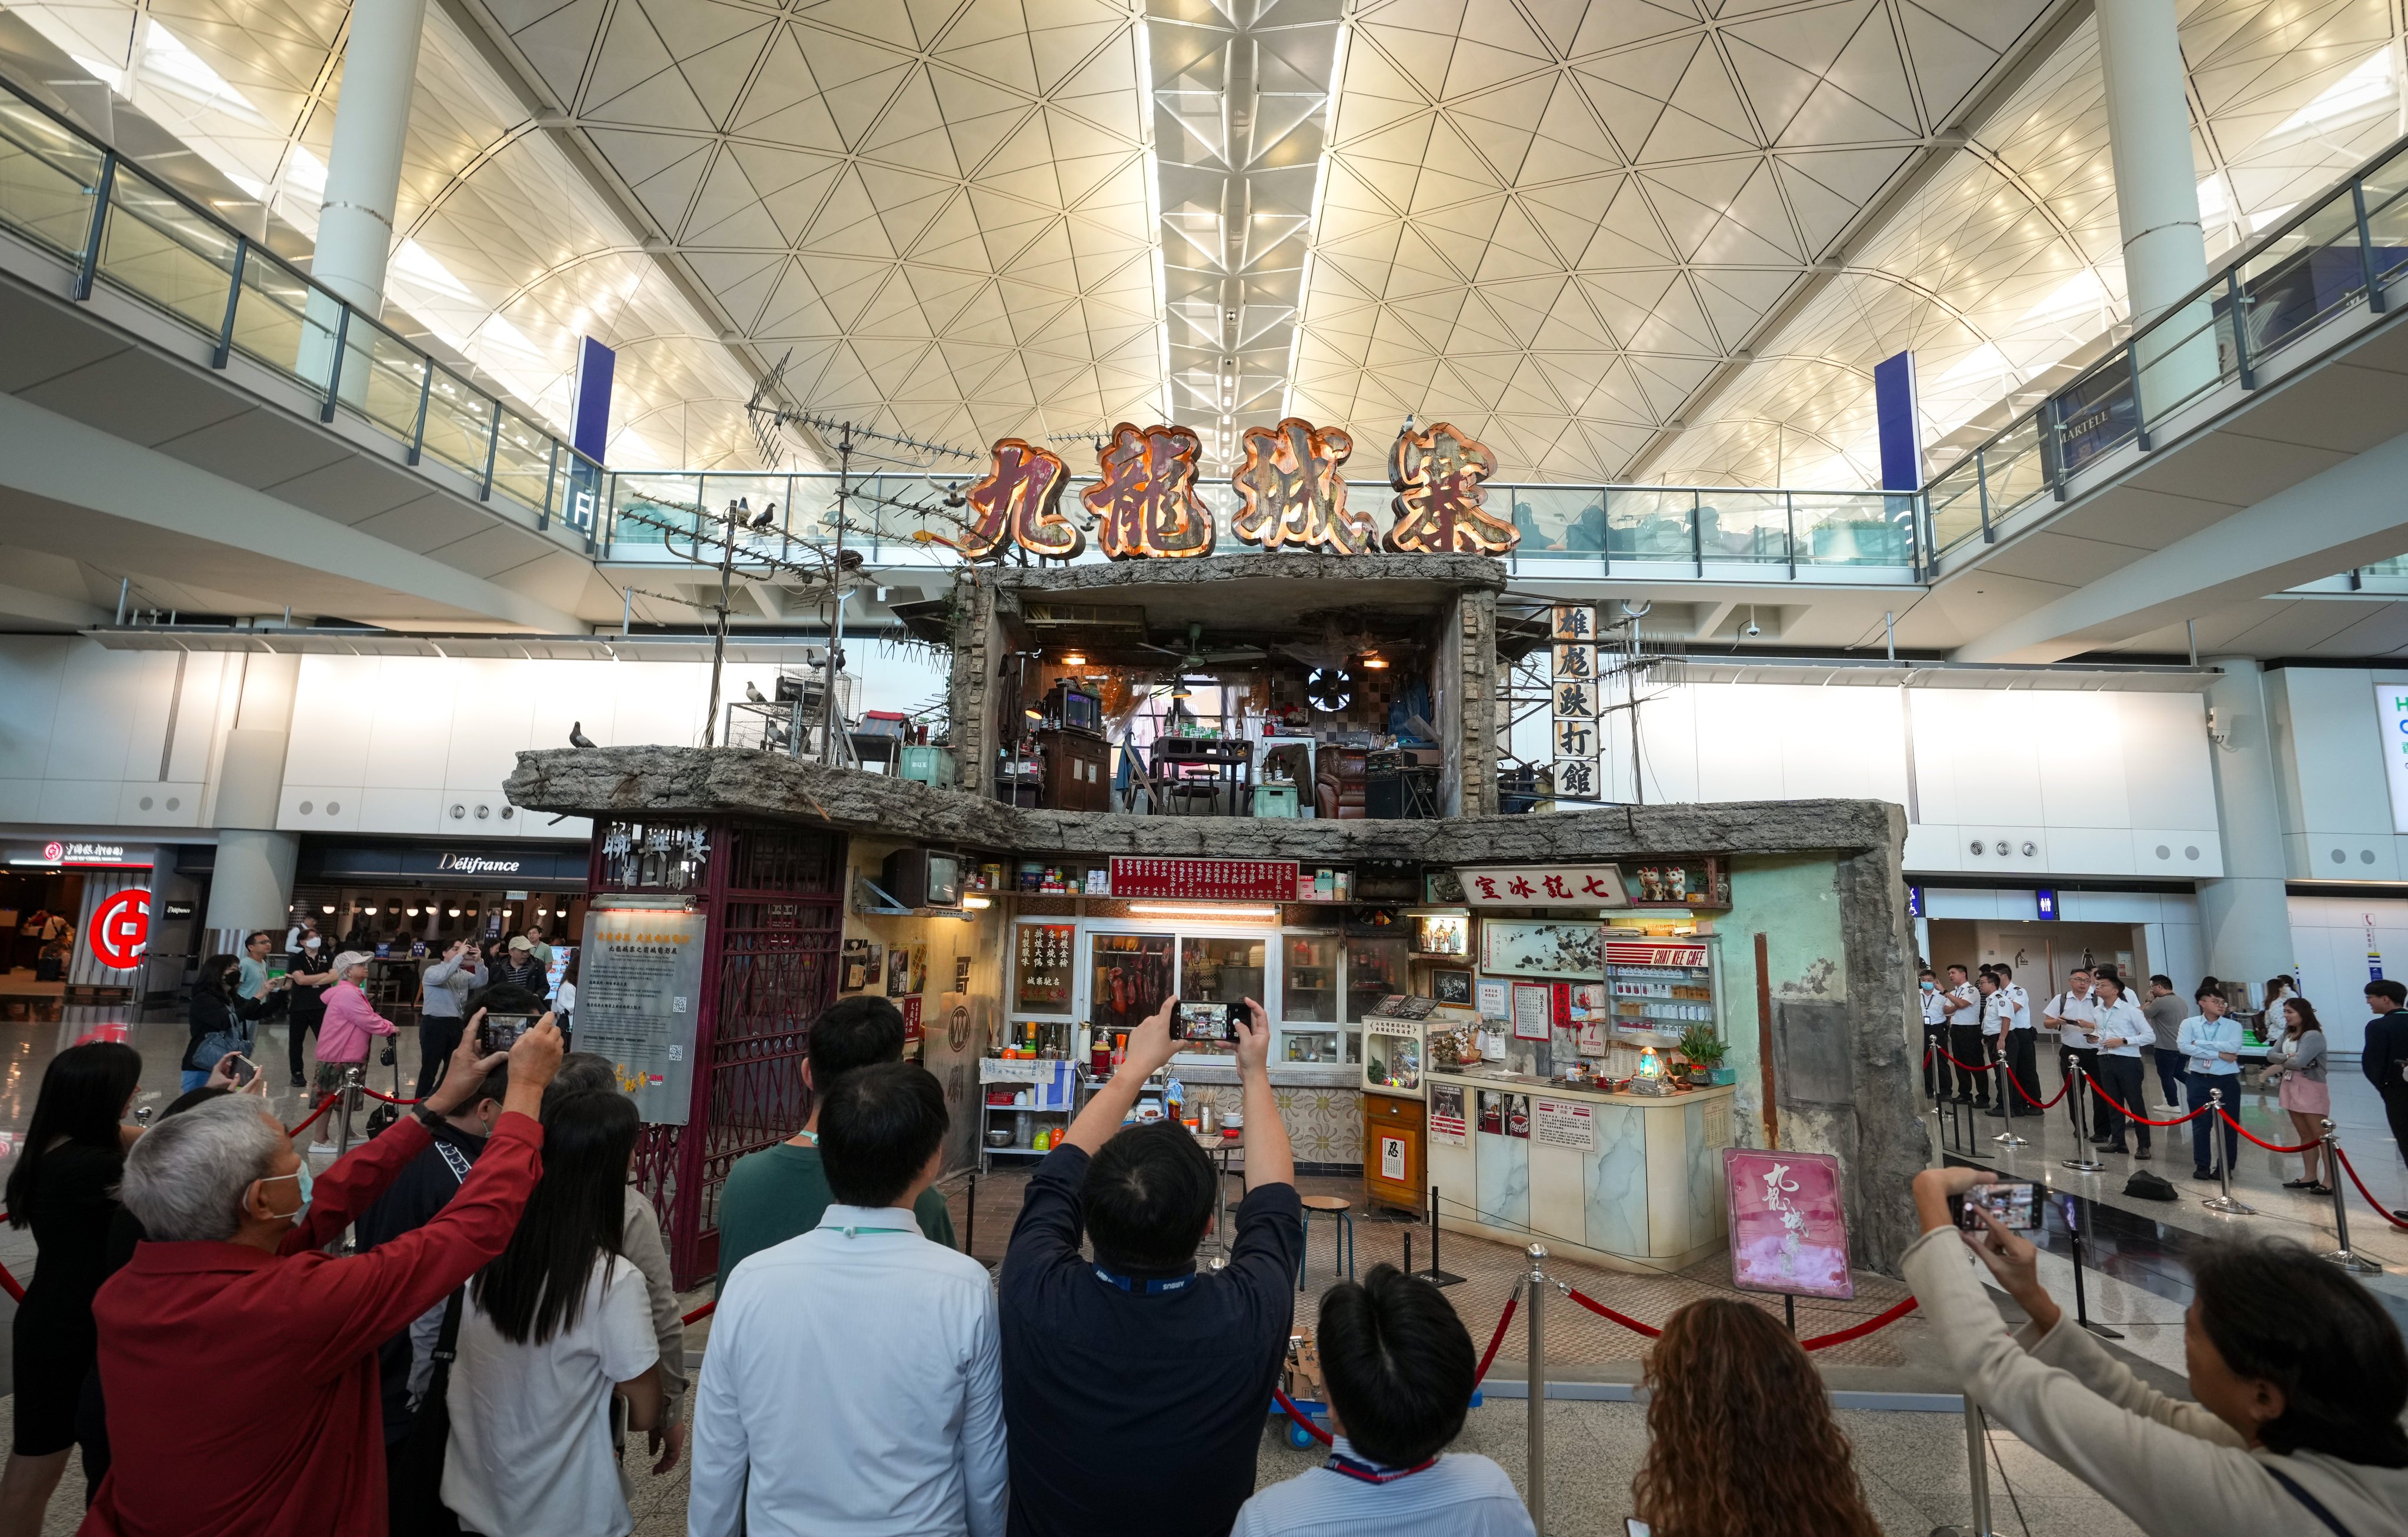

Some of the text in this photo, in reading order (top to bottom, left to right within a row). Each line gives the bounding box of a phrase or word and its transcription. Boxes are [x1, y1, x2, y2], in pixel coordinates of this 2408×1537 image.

[1557, 607, 1592, 794] 雄彪跌打館
[437, 853, 520, 874] Délifrance
[1475, 875, 1609, 900] 七記冰室
[1047, 929, 1056, 967] 各式燒味
[1654, 950, 1705, 966] CHAT KEE CAFE
[1027, 976, 1060, 986] 城寨馳名
[1588, 1023, 1597, 1040] 7
[1388, 1141, 1399, 1158] 忍
[1762, 1162, 1810, 1255] 九龍城寨
[1163, 1280, 1185, 1291] AIRBUS
